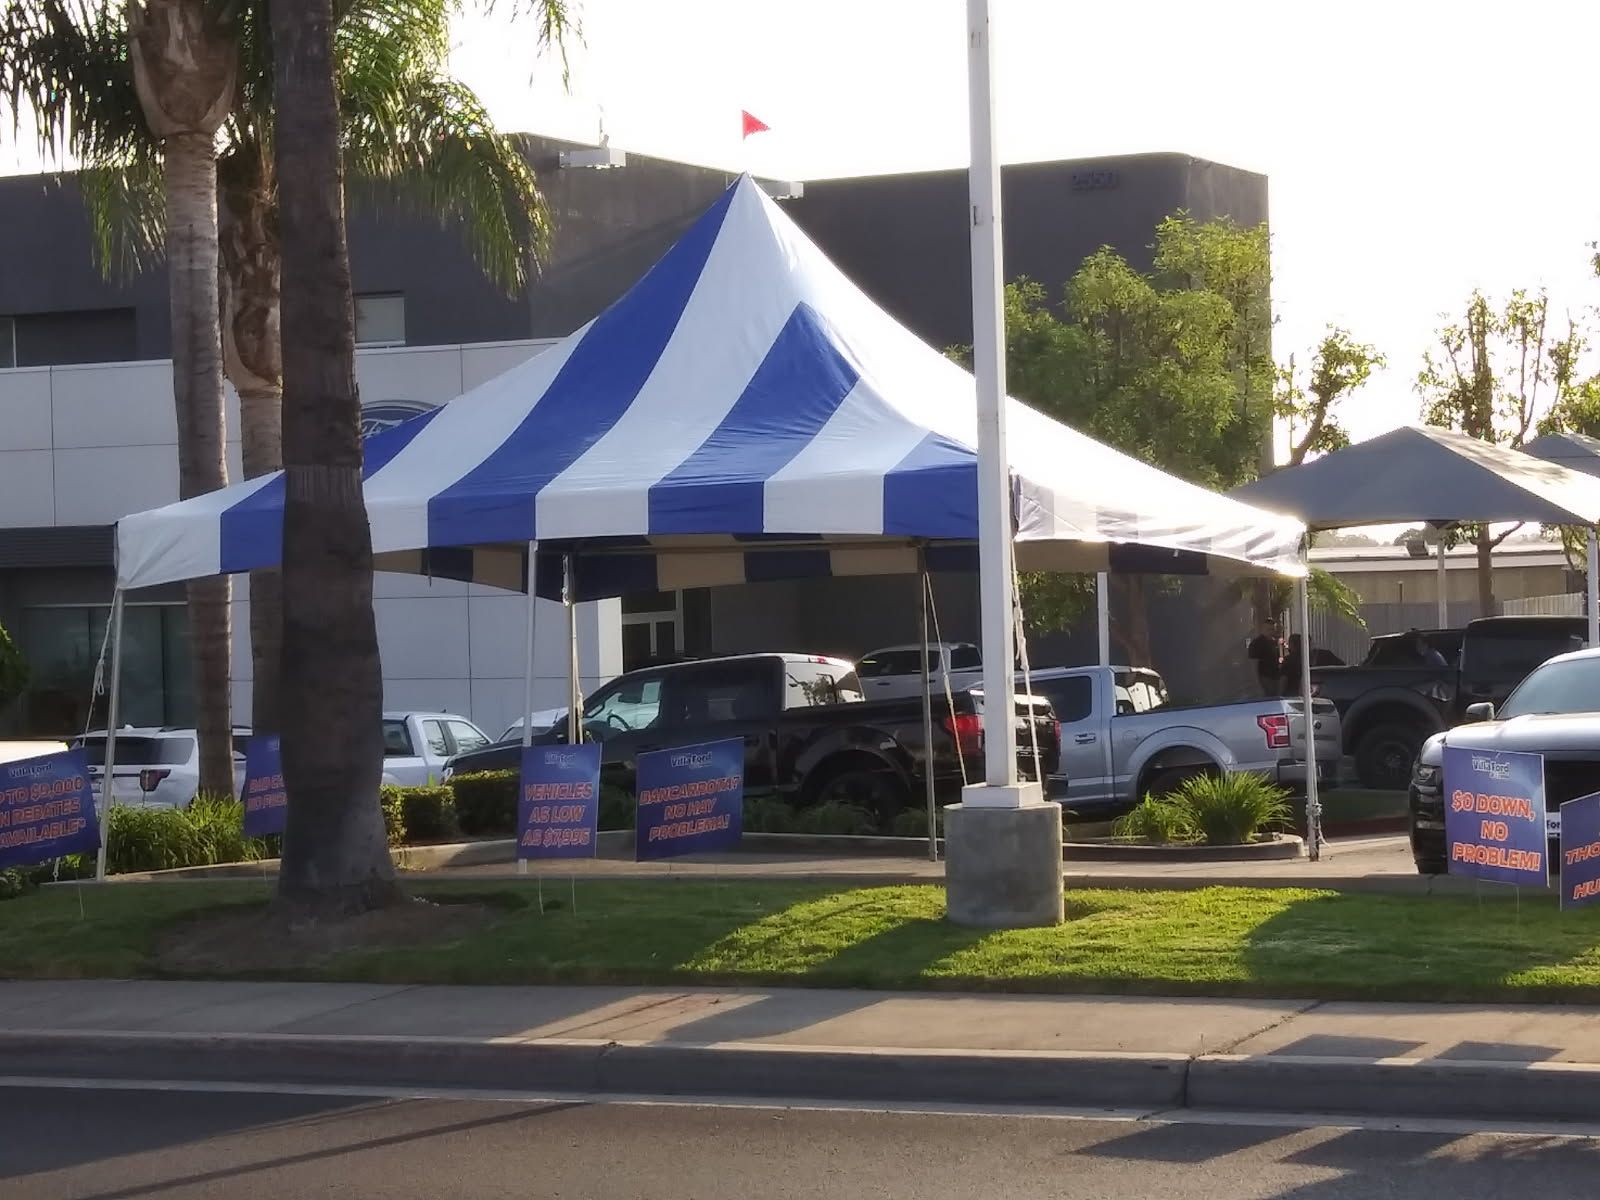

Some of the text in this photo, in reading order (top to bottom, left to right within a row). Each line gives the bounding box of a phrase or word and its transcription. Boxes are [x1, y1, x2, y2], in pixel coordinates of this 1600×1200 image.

[1472, 758, 1510, 773] Villa Ford
[525, 782, 593, 801] VEHICLES
[12, 797, 80, 825] REBATES
[528, 805, 586, 824] AS LOW
[663, 797, 717, 821] NO HAY
[1452, 790, 1536, 822] $0 DOWN,
[521, 829, 542, 846] AS
[648, 814, 731, 842] PROBLEMA!
[1480, 820, 1508, 841] NO
[1452, 842, 1542, 872] PROBLEM!
